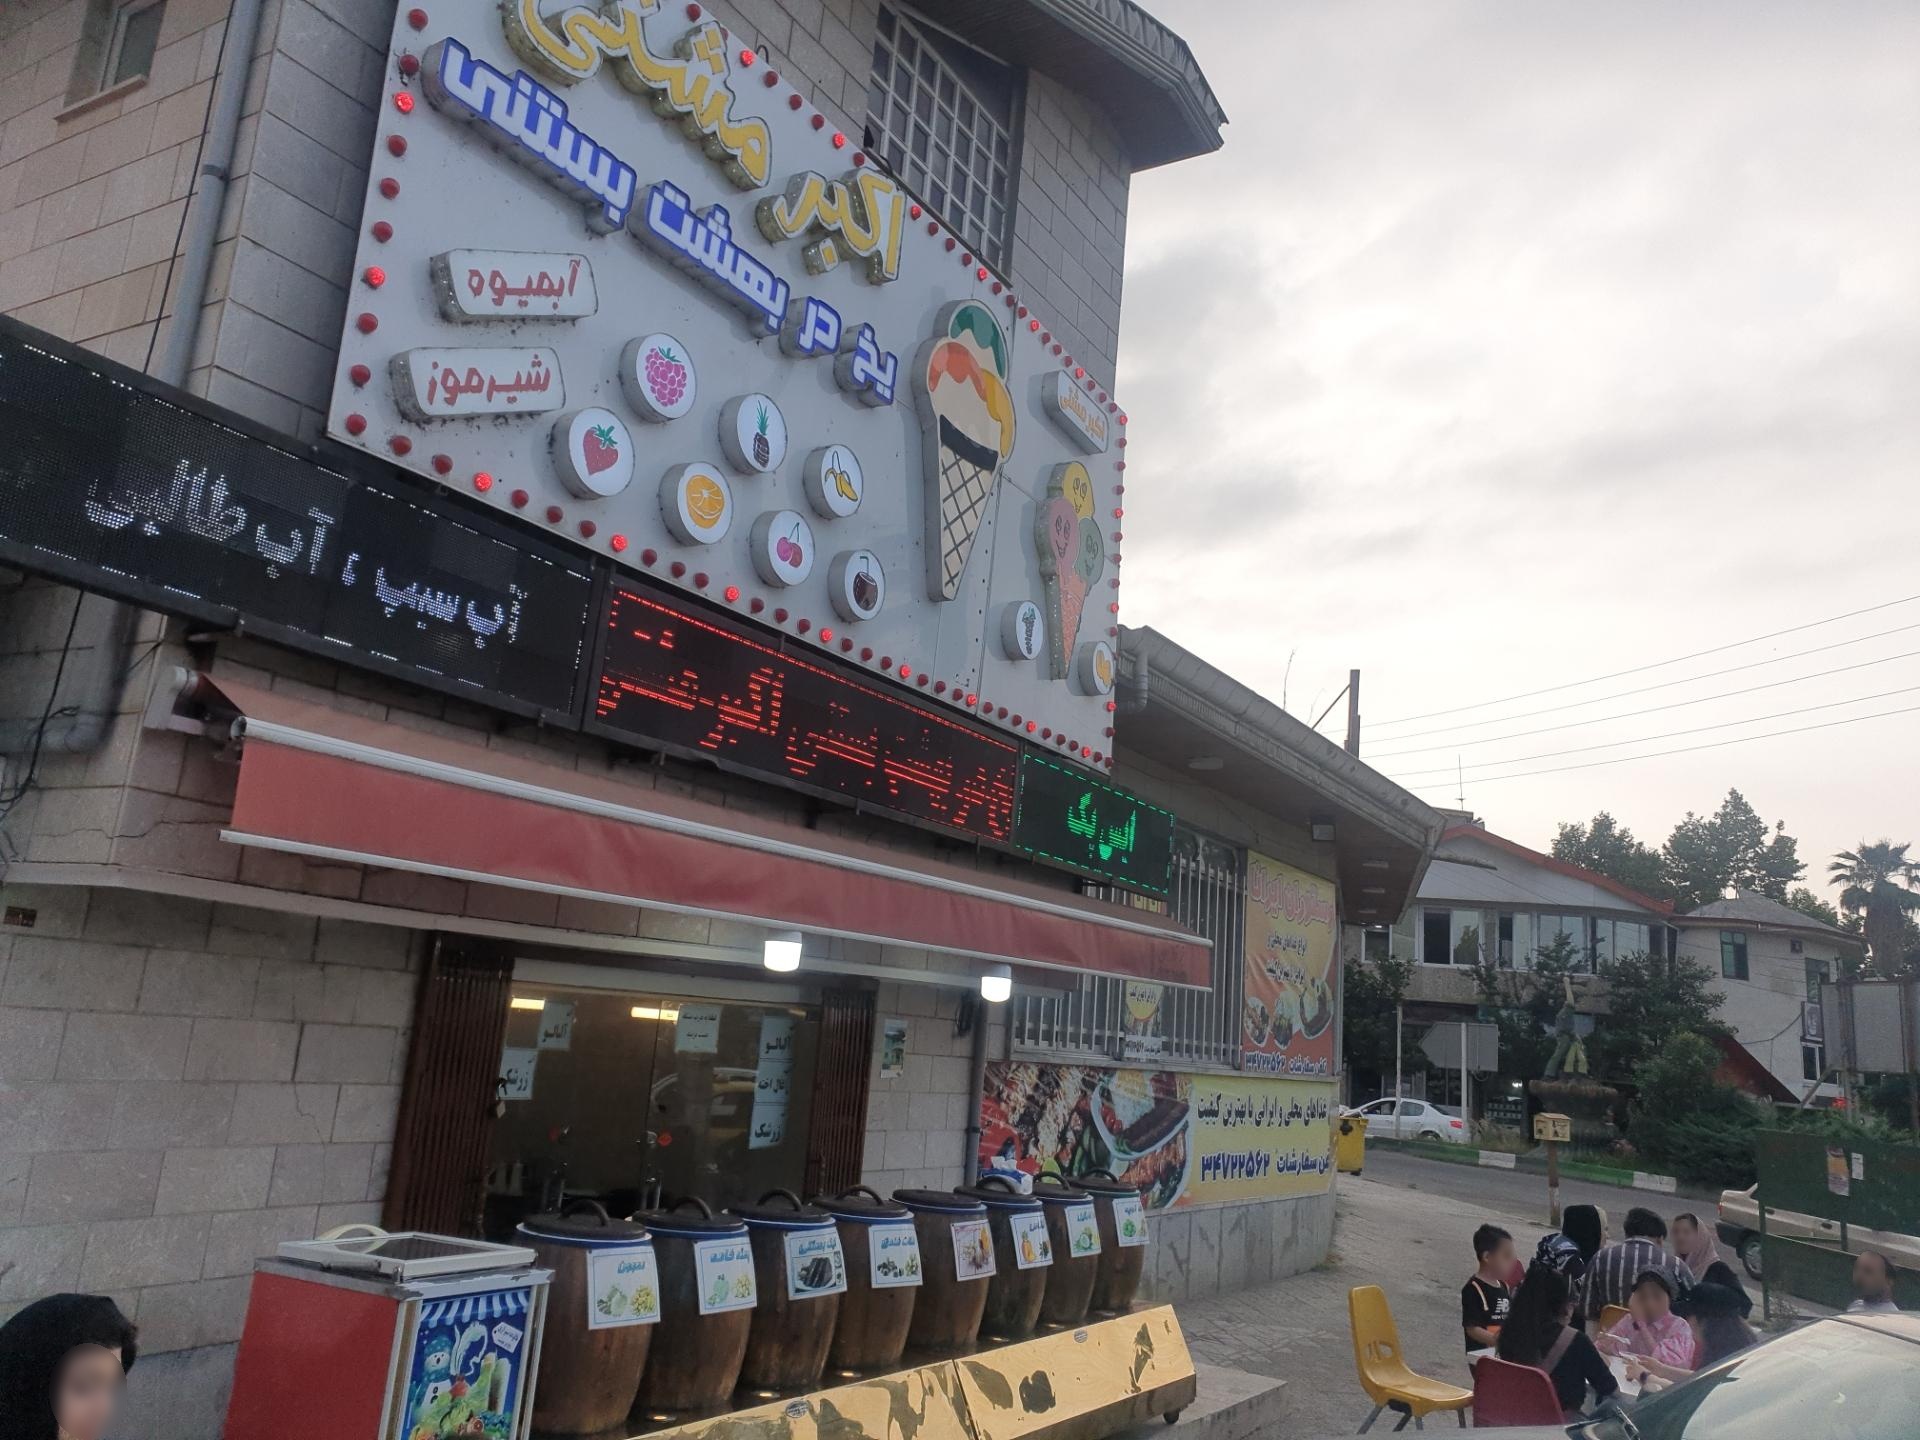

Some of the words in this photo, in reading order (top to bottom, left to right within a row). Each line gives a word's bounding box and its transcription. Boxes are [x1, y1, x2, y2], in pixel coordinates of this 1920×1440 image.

[441, 37, 637, 230] بستنی
[774, 168, 906, 282] اکبر
[468, 259, 581, 310] آبمیوه
[646, 180, 790, 335] بهشت
[797, 296, 841, 354] در
[427, 353, 551, 406] شیرموز
[851, 322, 897, 404] یخ
[85, 459, 246, 541] طالبی
[255, 506, 335, 579] آب
[466, 583, 528, 649] آب
[1197, 1093, 1222, 1125] کیفیت
[1223, 1097, 1246, 1127] بهترین
[1255, 1095, 1277, 1127] ایرانی
[1285, 1097, 1302, 1127] محلی
[1201, 1149, 1270, 1181] ۳۴۷۲۲۵۶۲
[1275, 1148, 1317, 1176] سفارشات
